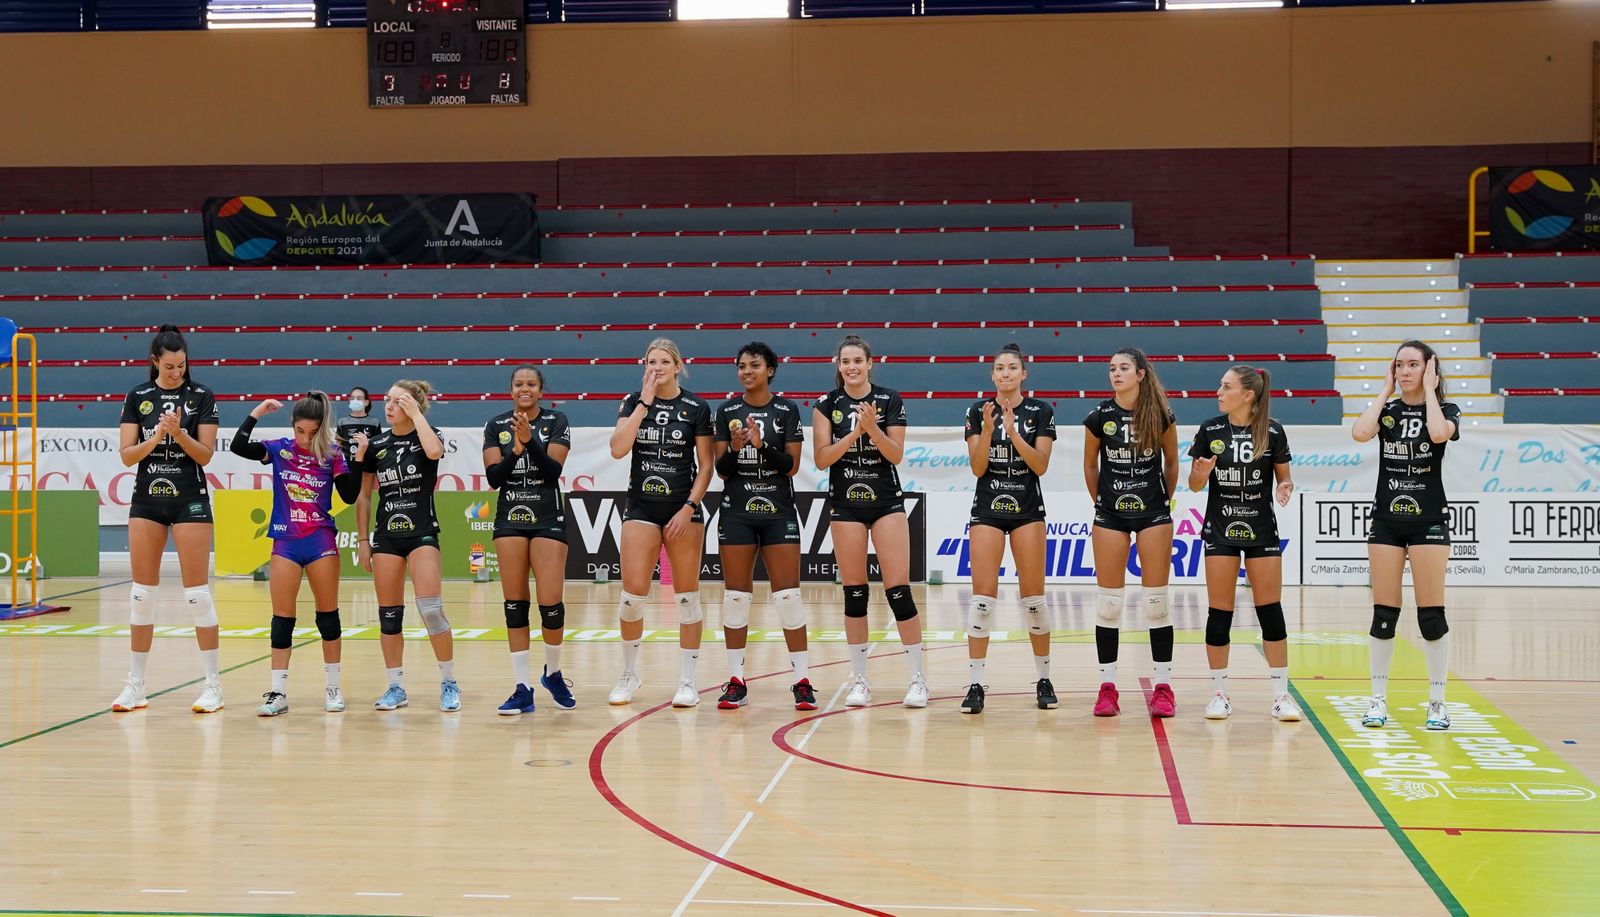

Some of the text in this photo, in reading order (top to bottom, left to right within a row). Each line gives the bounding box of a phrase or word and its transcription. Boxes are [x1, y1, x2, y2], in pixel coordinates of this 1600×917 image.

[373, 22, 414, 33] LOCAL
[476, 19, 517, 31] VISITANTE
[431, 53, 461, 62] PERIODO
[376, 96, 405, 105] FALTAS
[429, 95, 466, 105] JUGADOR
[490, 94, 520, 104] FALTAS
[286, 202, 391, 229] Andalucía
[286, 234, 380, 246] Región Europea del
[424, 237, 503, 248] Junta de Andalucía
[286, 246, 363, 255] DEPORTE 2021
[655, 411, 670, 426] 6
[1399, 418, 1423, 439] 18
[40, 438, 113, 453] EXCMO.
[1383, 439, 1409, 455] berlin
[1105, 445, 1131, 459] berlin
[1229, 440, 1254, 464] 16
[1518, 440, 1567, 464] Dos
[1215, 466, 1241, 482] berlin
[152, 486, 172, 495] SHC
[645, 484, 665, 493] SHC
[850, 490, 871, 499] SHC
[750, 503, 770, 512] SHC
[994, 502, 1015, 511] SHC
[1119, 501, 1140, 510] SHC
[1393, 503, 1415, 512] SHC
[511, 513, 531, 522] SHC
[1318, 503, 1340, 538] LA
[1512, 503, 1535, 538] LA
[273, 524, 288, 532] WAY
[390, 521, 409, 530] SHC
[1229, 529, 1250, 538] SHC
[1453, 544, 1477, 556] COPAS
[587, 563, 620, 574] DOS
[1311, 564, 1341, 575] C/María
[1454, 564, 1486, 576] (Sevilla)
[1505, 565, 1535, 576] C/María
[1451, 736, 1566, 773] juega
[1363, 751, 1450, 779] Dos
